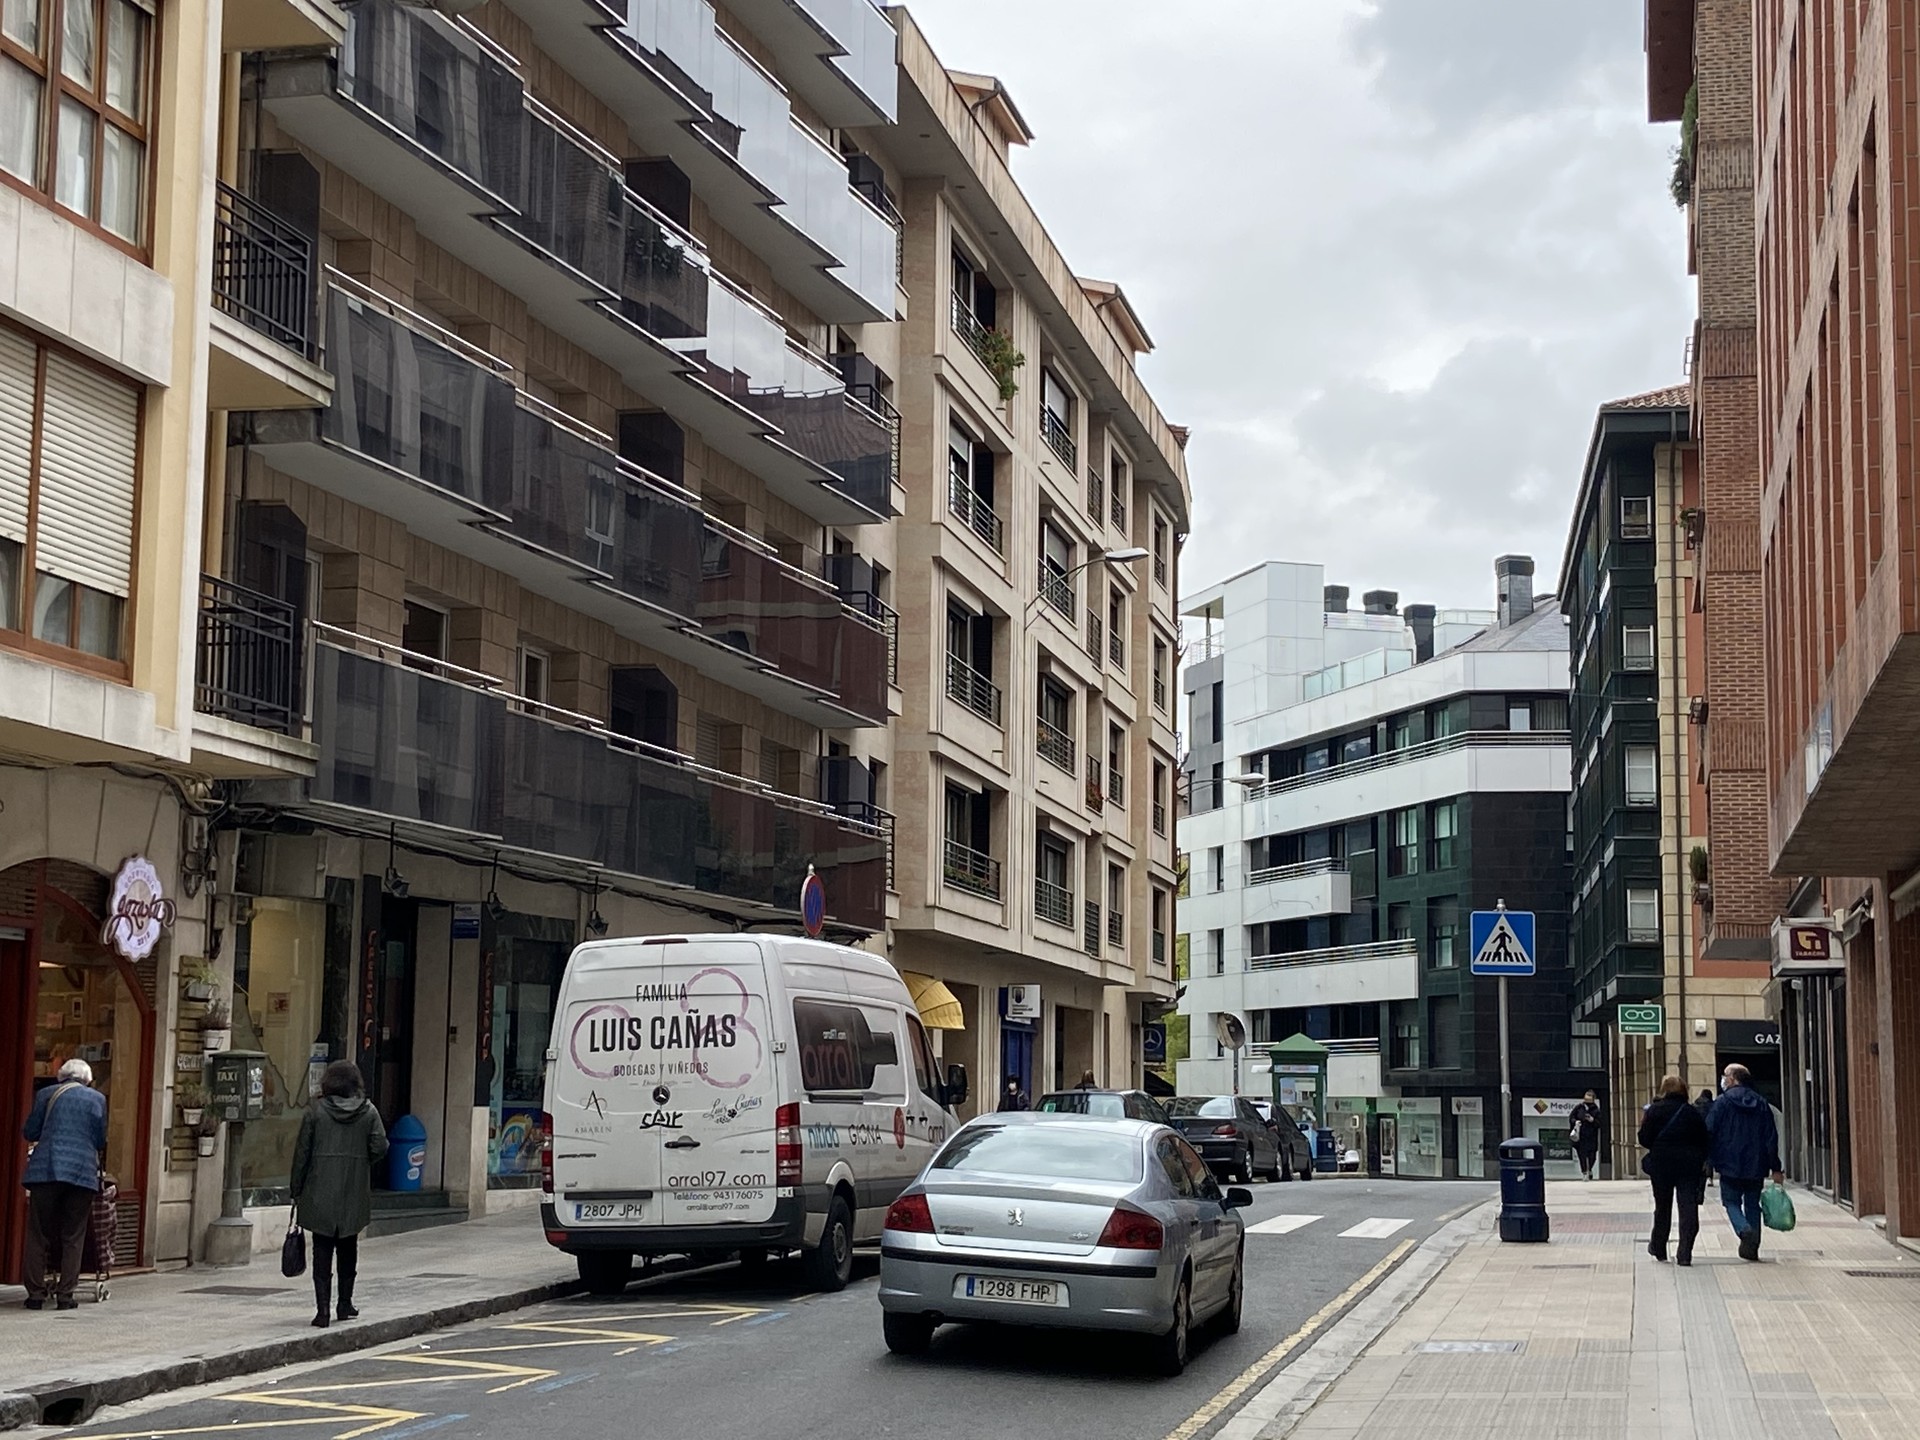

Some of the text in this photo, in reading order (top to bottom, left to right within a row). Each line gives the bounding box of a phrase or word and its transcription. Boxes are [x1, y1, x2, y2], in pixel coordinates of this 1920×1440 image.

[636, 983, 688, 1002] FAMILIA
[590, 1009, 736, 1052] LUIS CAÑAS
[216, 1071, 239, 1082] TAXI
[614, 1060, 709, 1077] BODEGAS Y VIÑEDOS
[668, 1170, 766, 1187] arral97.com
[713, 1190, 764, 1200] 943176075
[583, 1204, 643, 1218] 2807 JPH
[979, 1279, 1050, 1300] 1298 FHP
